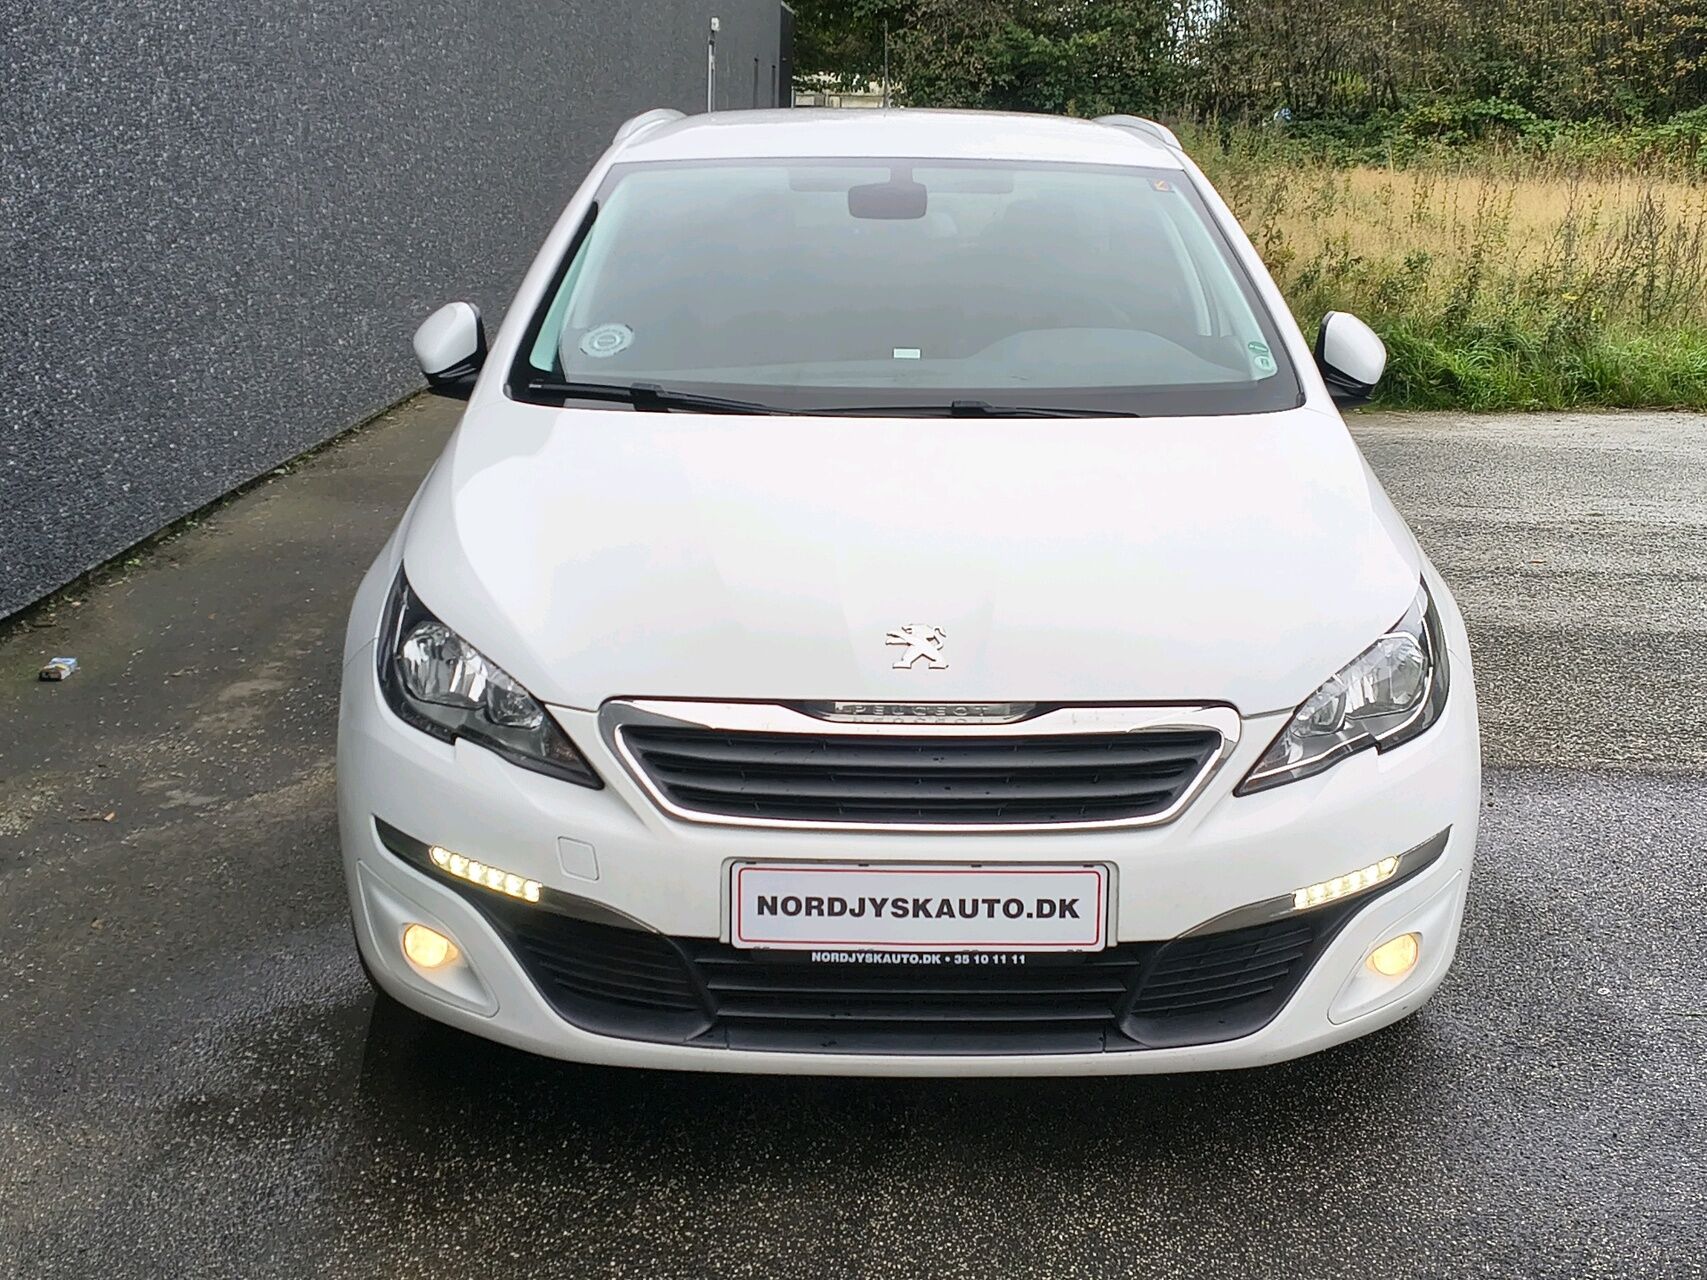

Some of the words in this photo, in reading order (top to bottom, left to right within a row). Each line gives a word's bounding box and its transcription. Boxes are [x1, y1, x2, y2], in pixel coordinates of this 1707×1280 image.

[854, 705, 988, 717] PEUGEOT
[757, 895, 1080, 919] NORDJYSKAUTO.DK
[811, 951, 941, 965] NORDJYSKAUTO.DK
[953, 953, 970, 965] 35
[973, 953, 989, 965] 10
[992, 953, 1007, 965] 11
[1011, 953, 1026, 965] 11
